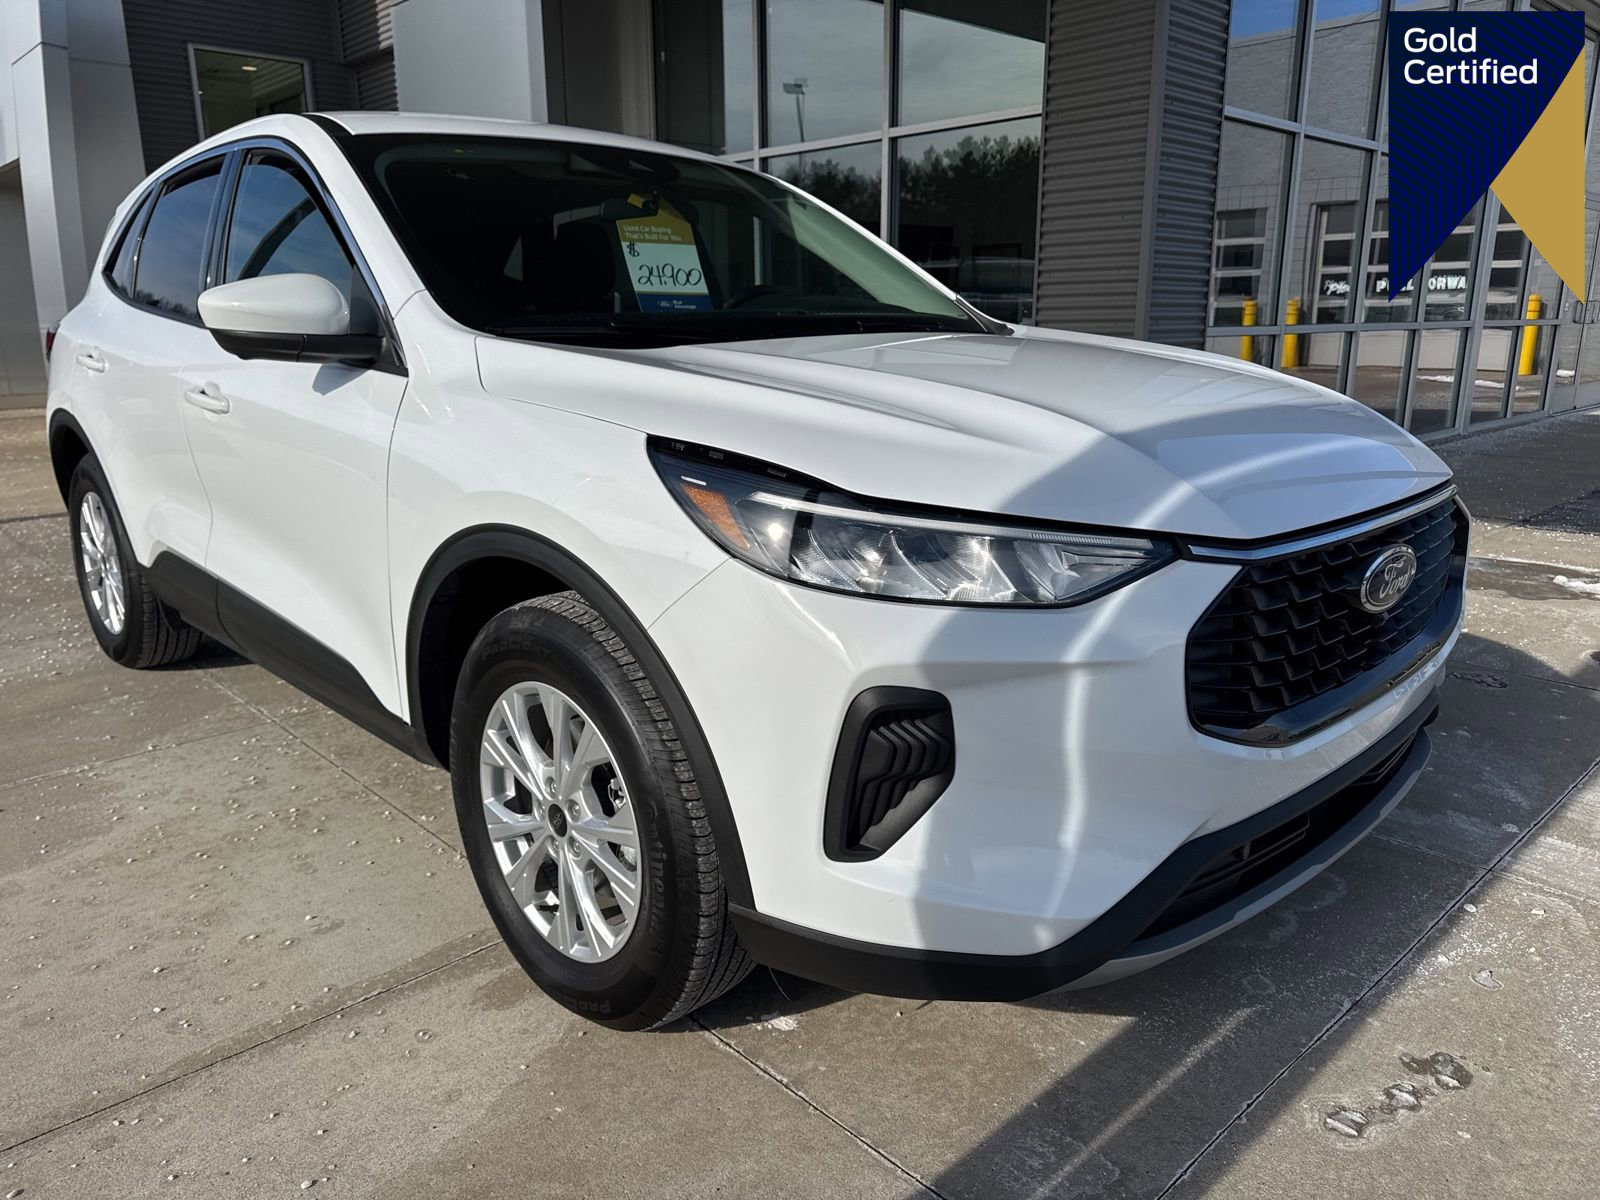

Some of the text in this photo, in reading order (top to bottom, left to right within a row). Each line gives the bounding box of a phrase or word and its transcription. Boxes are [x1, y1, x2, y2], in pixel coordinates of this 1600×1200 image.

[626, 241, 640, 257] $
[1427, 275, 1467, 291] ORWA
[1378, 555, 1412, 600] Ford
